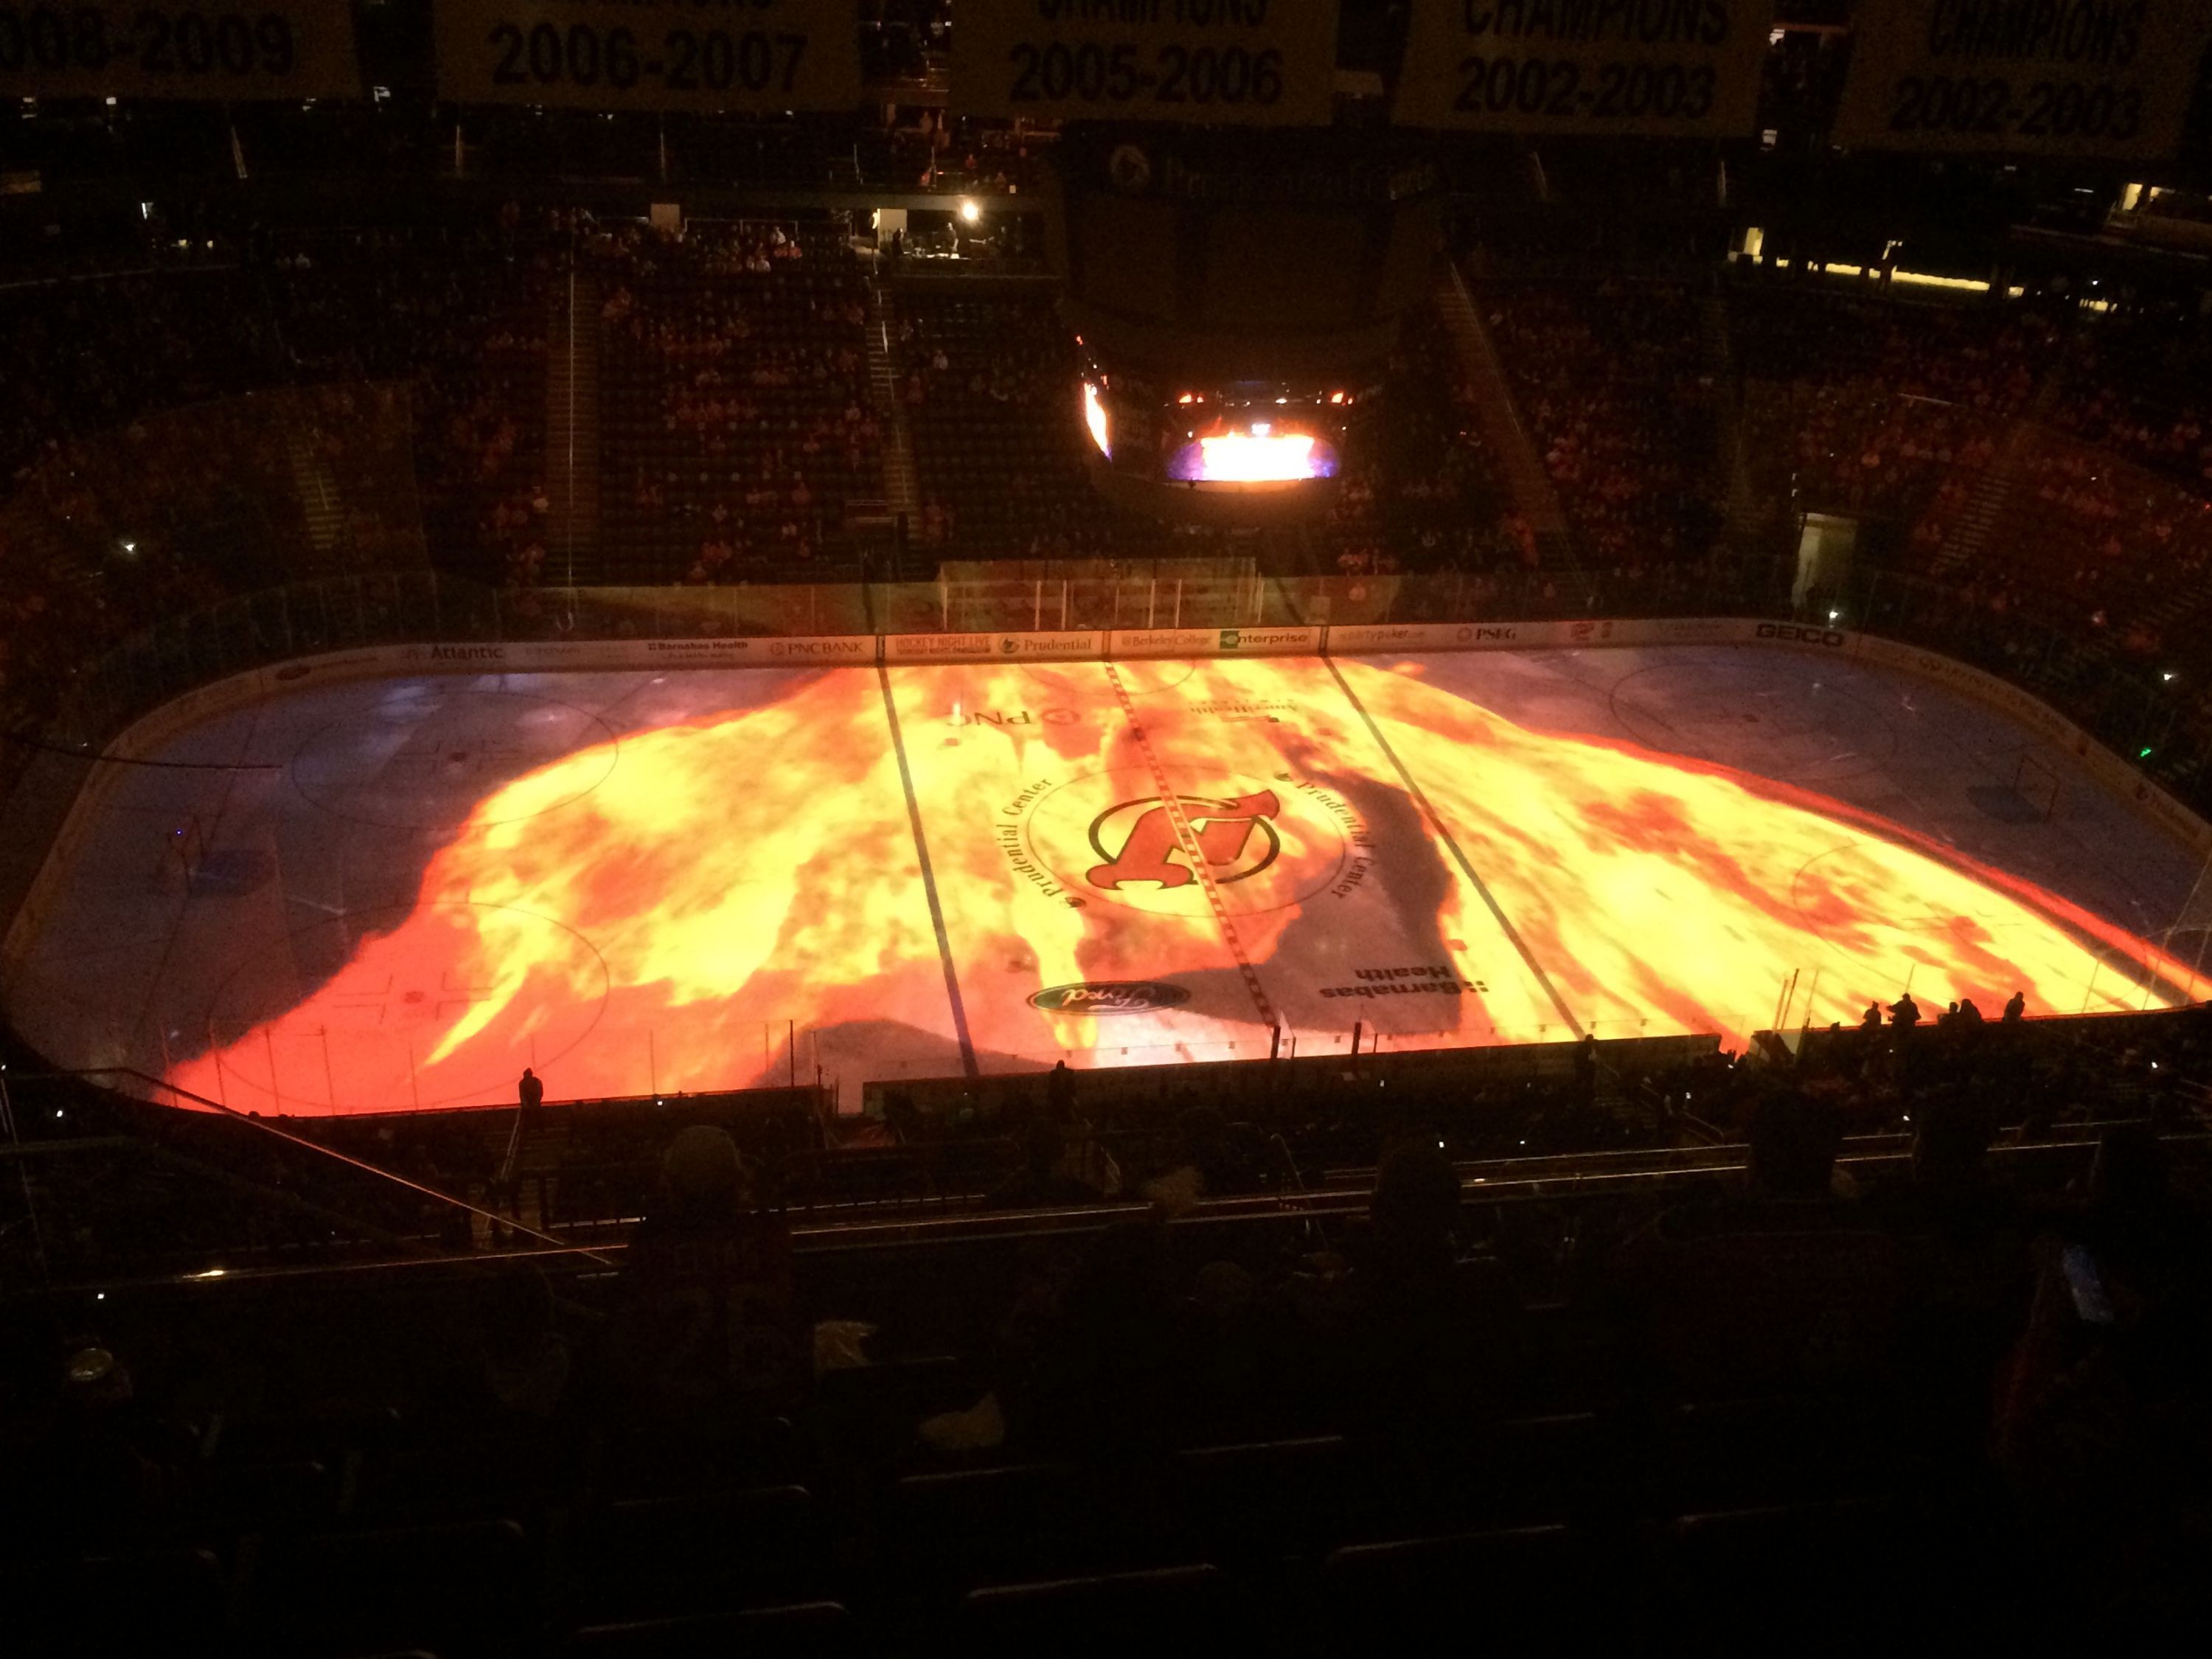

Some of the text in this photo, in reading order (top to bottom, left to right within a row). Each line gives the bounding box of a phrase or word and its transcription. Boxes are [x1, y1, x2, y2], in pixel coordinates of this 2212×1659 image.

[1465, 0, 1728, 45] CHAMPIONS
[1930, 0, 2146, 65] CHAMPIONS
[0, 6, 293, 75] 008-2009
[487, 21, 810, 91] 2006-2007
[1008, 38, 1284, 105] 2005-2006
[1453, 57, 1717, 119] 2002-2003
[1889, 74, 2143, 140] 2002-2003
[658, 641, 748, 651] Barnabas Health
[896, 635, 991, 649] HOCKEY NIGHT LIVE
[1023, 637, 1093, 652] Prudential
[1133, 636, 1172, 649] Berkeley
[1755, 623, 1846, 647] GEICO
[431, 645, 504, 660] Atlantic
[944, 710, 1032, 727] PNC
[997, 779, 1063, 897] Prudential Center
[1295, 782, 1376, 899] Prudential Center
[1354, 965, 1453, 981] Health
[1062, 986, 1157, 1011] Ford
[1319, 980, 1463, 998] Barnabas
